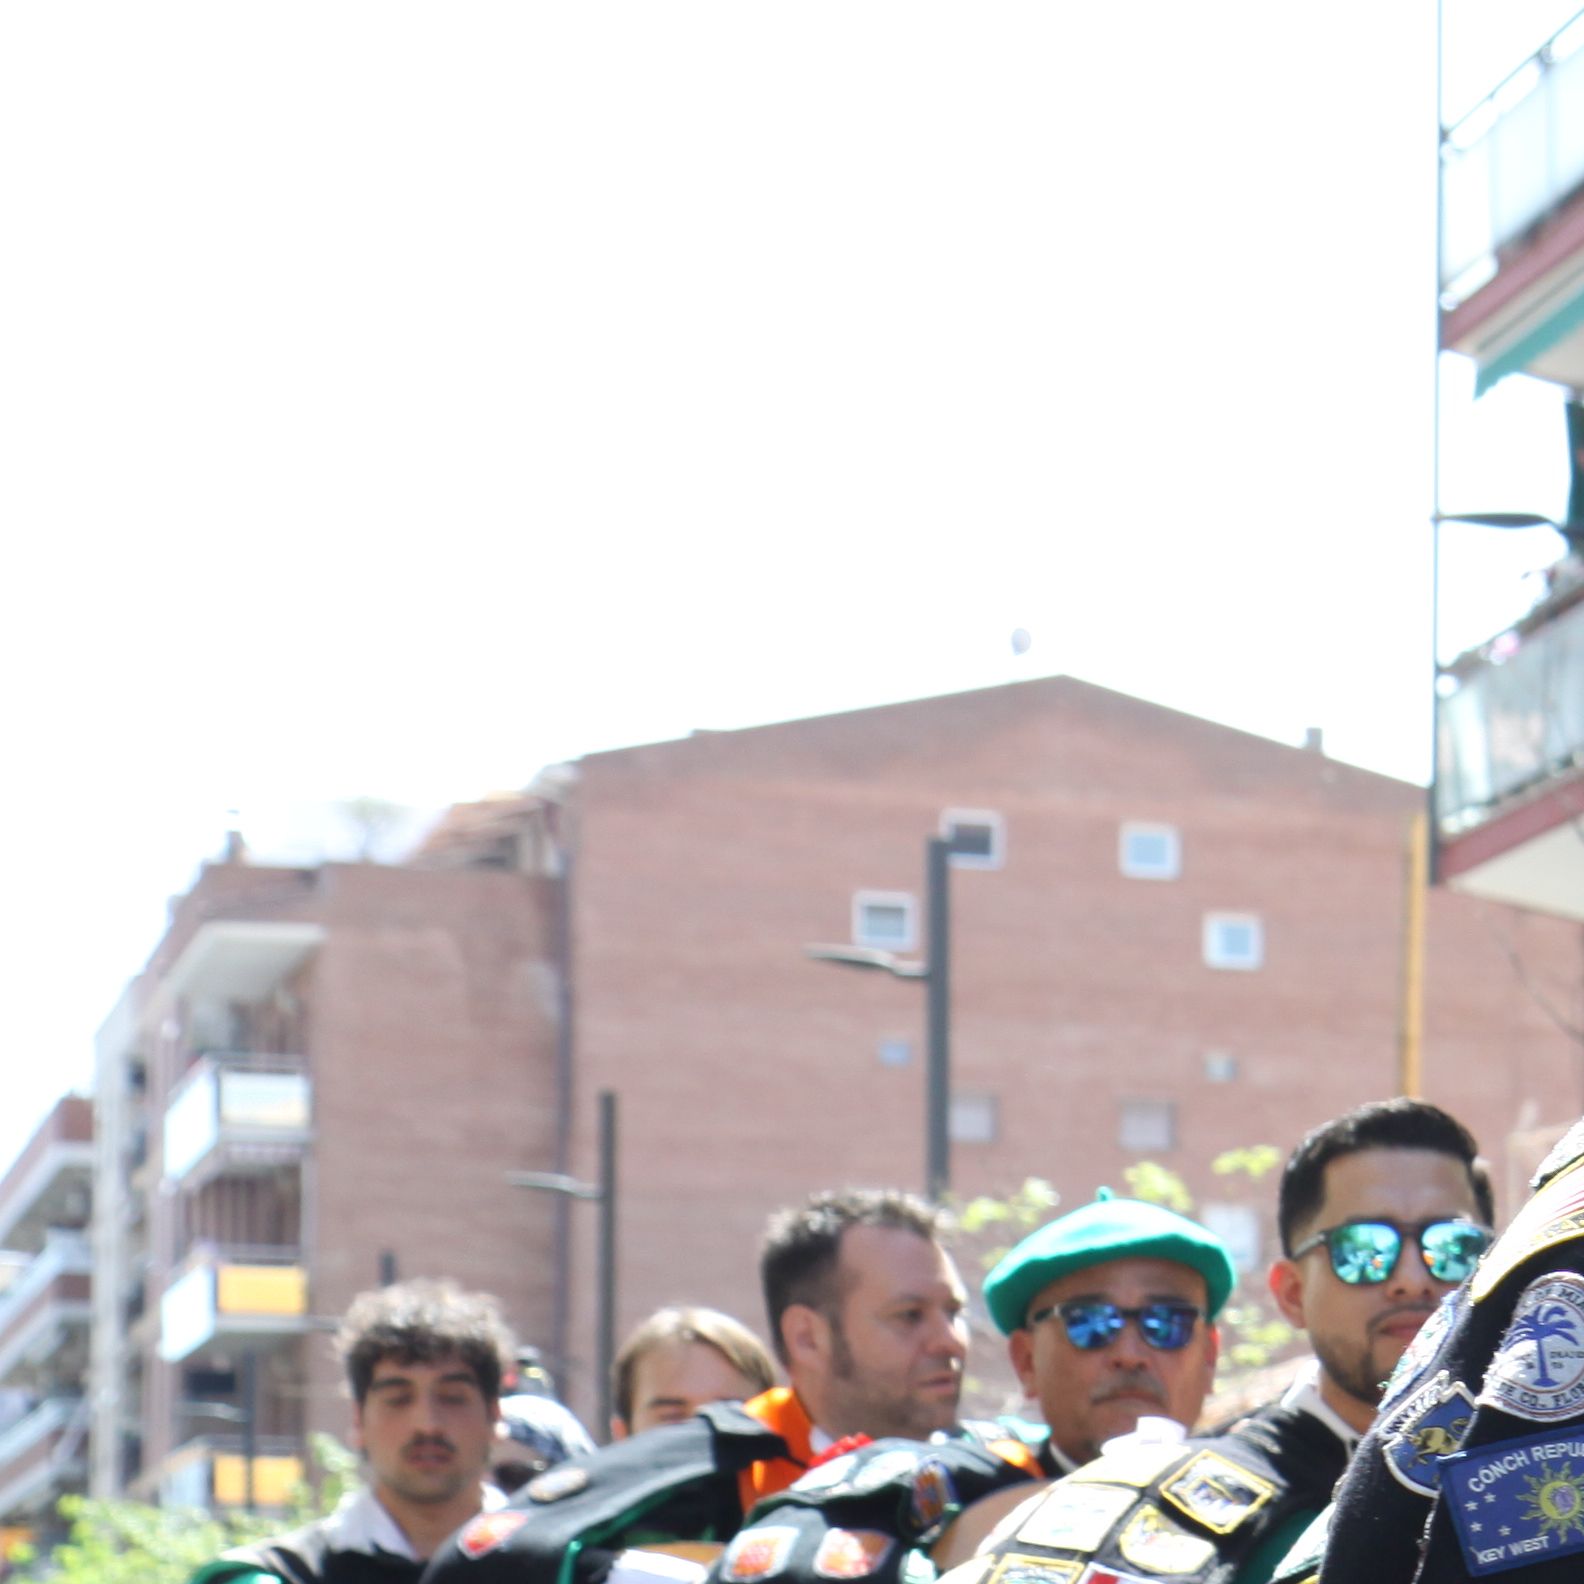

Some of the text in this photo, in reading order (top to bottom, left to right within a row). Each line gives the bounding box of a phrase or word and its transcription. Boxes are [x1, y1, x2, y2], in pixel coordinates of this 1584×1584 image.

[1467, 1449, 1531, 1493] CONCH
[1476, 1535, 1550, 1565] KEY WEST
